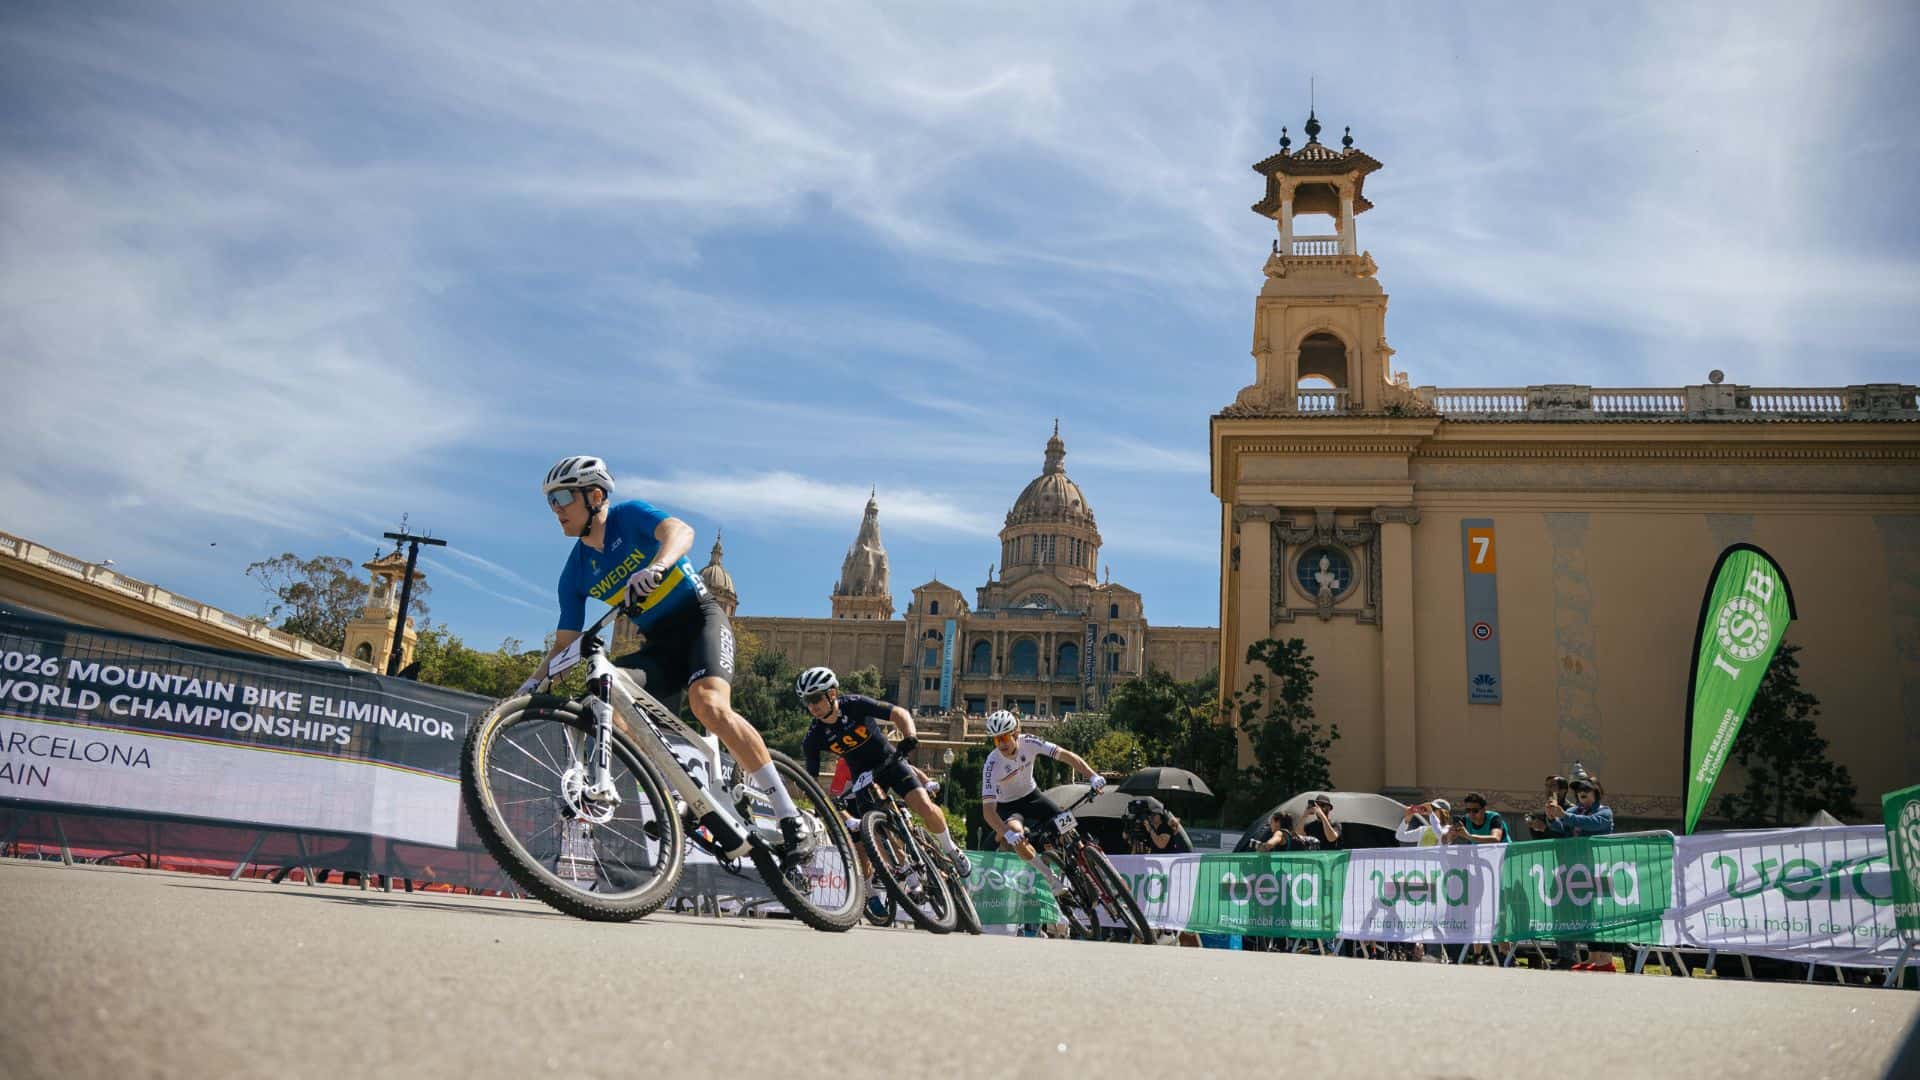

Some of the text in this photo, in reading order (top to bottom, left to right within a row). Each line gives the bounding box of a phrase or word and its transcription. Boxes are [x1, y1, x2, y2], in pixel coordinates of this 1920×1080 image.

[1472, 536, 1489, 564] 7
[589, 548, 646, 599] SWEDEN
[719, 624, 734, 673] SWEDEN
[0, 651, 454, 741] 026 MOUNTAIN BIKE ELIMINATOR
[109, 694, 351, 745] CHAMPIONSHIPS
[0, 731, 151, 769] RCELONA
[1696, 708, 1735, 783] SPORT BEARINGS
[1058, 815, 1072, 827] 24
[1222, 872, 1319, 906] vera
[1370, 868, 1469, 907] vera
[1529, 862, 1639, 906] vera
[1706, 912, 1748, 929] Fibra
[1818, 919, 1841, 934] de
[1847, 922, 1899, 938] verita
